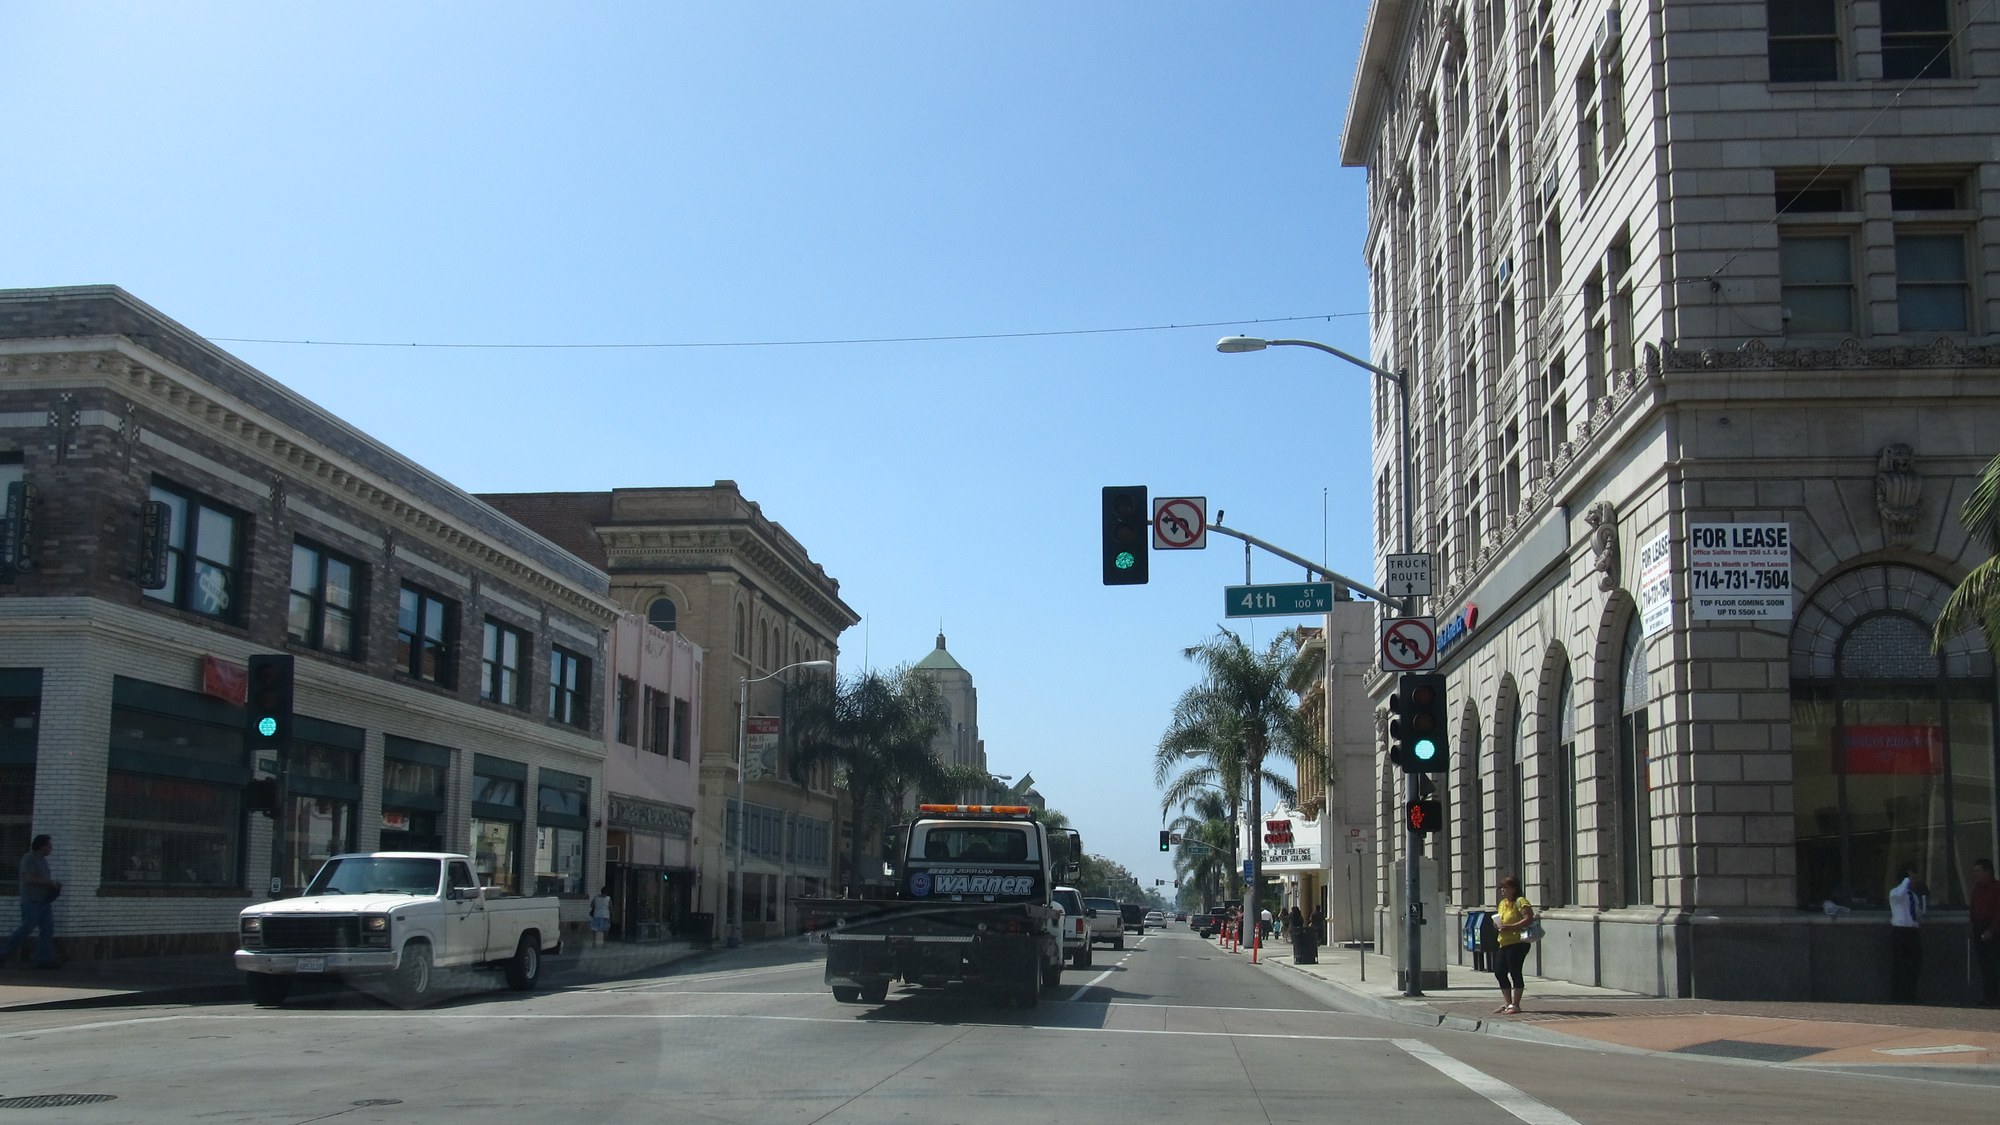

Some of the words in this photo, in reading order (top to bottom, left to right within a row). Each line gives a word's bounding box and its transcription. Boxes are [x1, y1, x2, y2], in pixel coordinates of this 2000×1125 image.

[1692, 528, 1727, 548] FOR
[1732, 528, 1788, 548] LEASE
[1641, 547, 1651, 570] FOR
[1652, 534, 1668, 563] LEASE
[1390, 559, 1428, 569] TRUCK
[1391, 572, 1426, 581] ROUTE
[1693, 570, 1790, 589] 714-731-7504
[1303, 589, 1315, 598] ST
[1240, 592, 1276, 609] 4th
[1294, 599, 1311, 609] 100
[1316, 599, 1324, 608] W
[1281, 848, 1311, 856] EXPERIENCE
